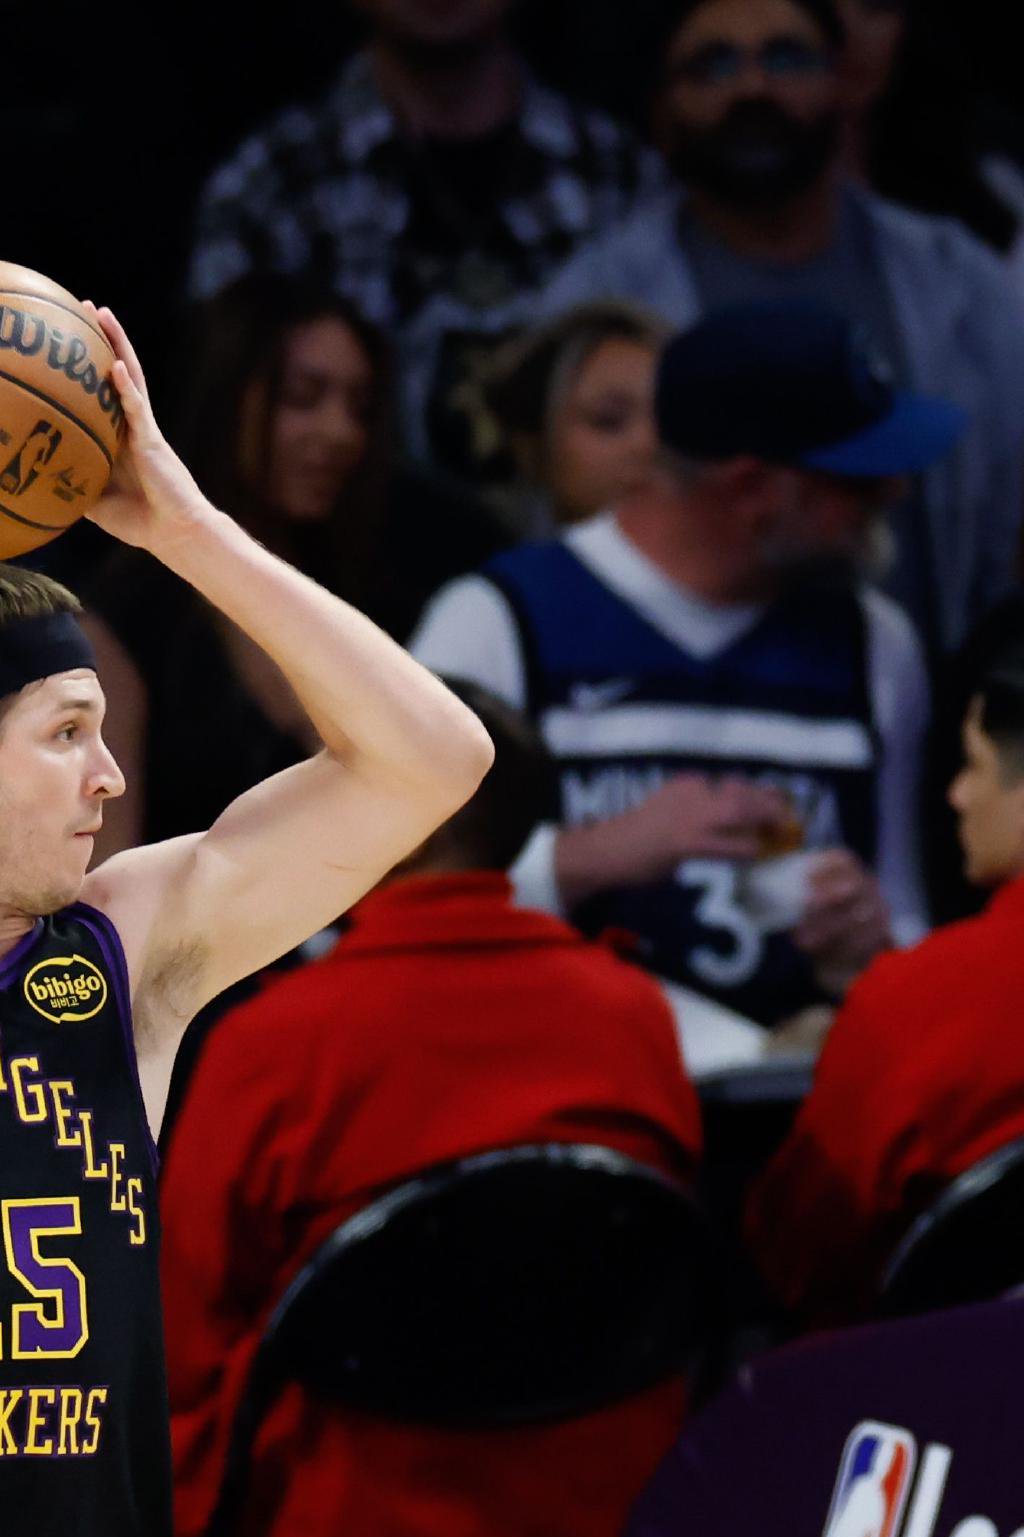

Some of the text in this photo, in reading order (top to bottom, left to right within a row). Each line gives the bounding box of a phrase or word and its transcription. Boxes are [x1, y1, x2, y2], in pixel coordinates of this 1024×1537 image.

[676, 859, 764, 987] 3
[30, 973, 101, 1000] bibigo
[49, 996, 80, 1009] 비비고
